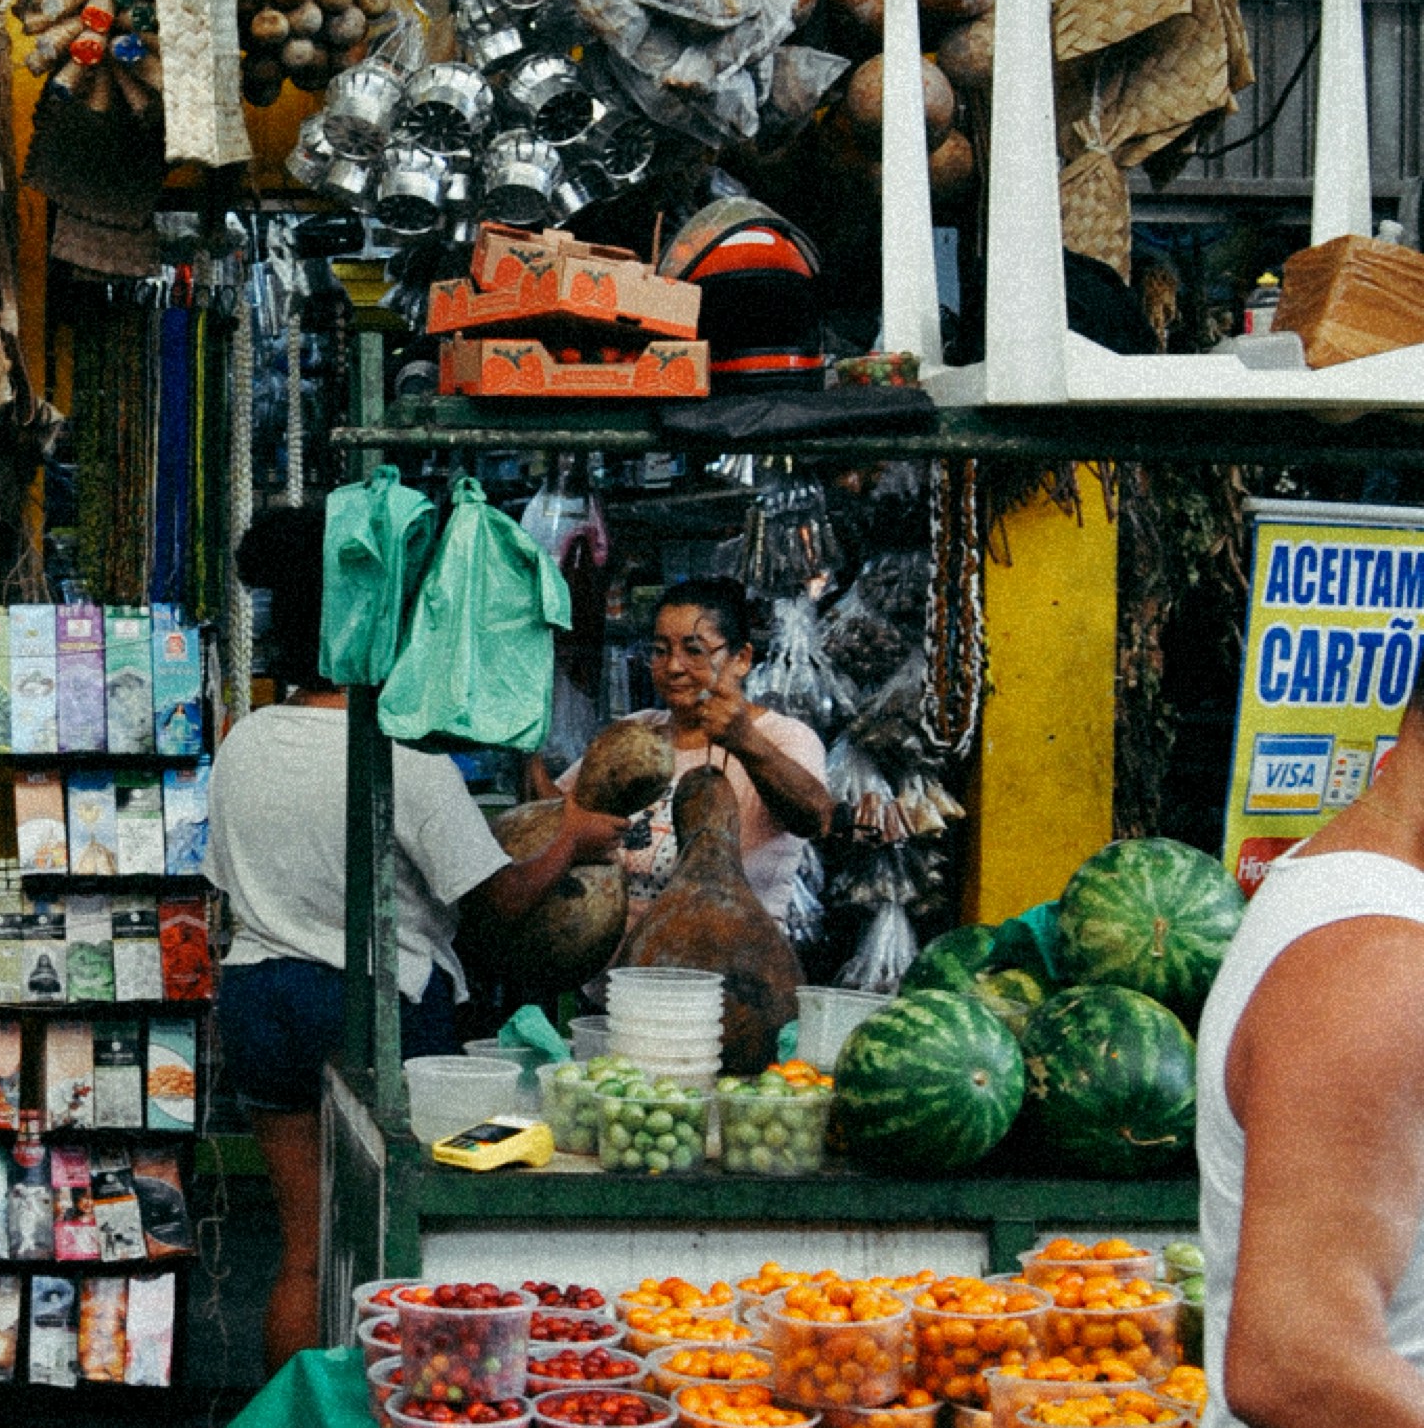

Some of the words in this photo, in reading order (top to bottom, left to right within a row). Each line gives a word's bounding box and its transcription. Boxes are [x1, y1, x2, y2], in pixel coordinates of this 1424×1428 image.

[1265, 544, 1424, 609] ACEITAM
[1259, 616, 1424, 706] CARTÕ
[1266, 762, 1316, 788] VISA
